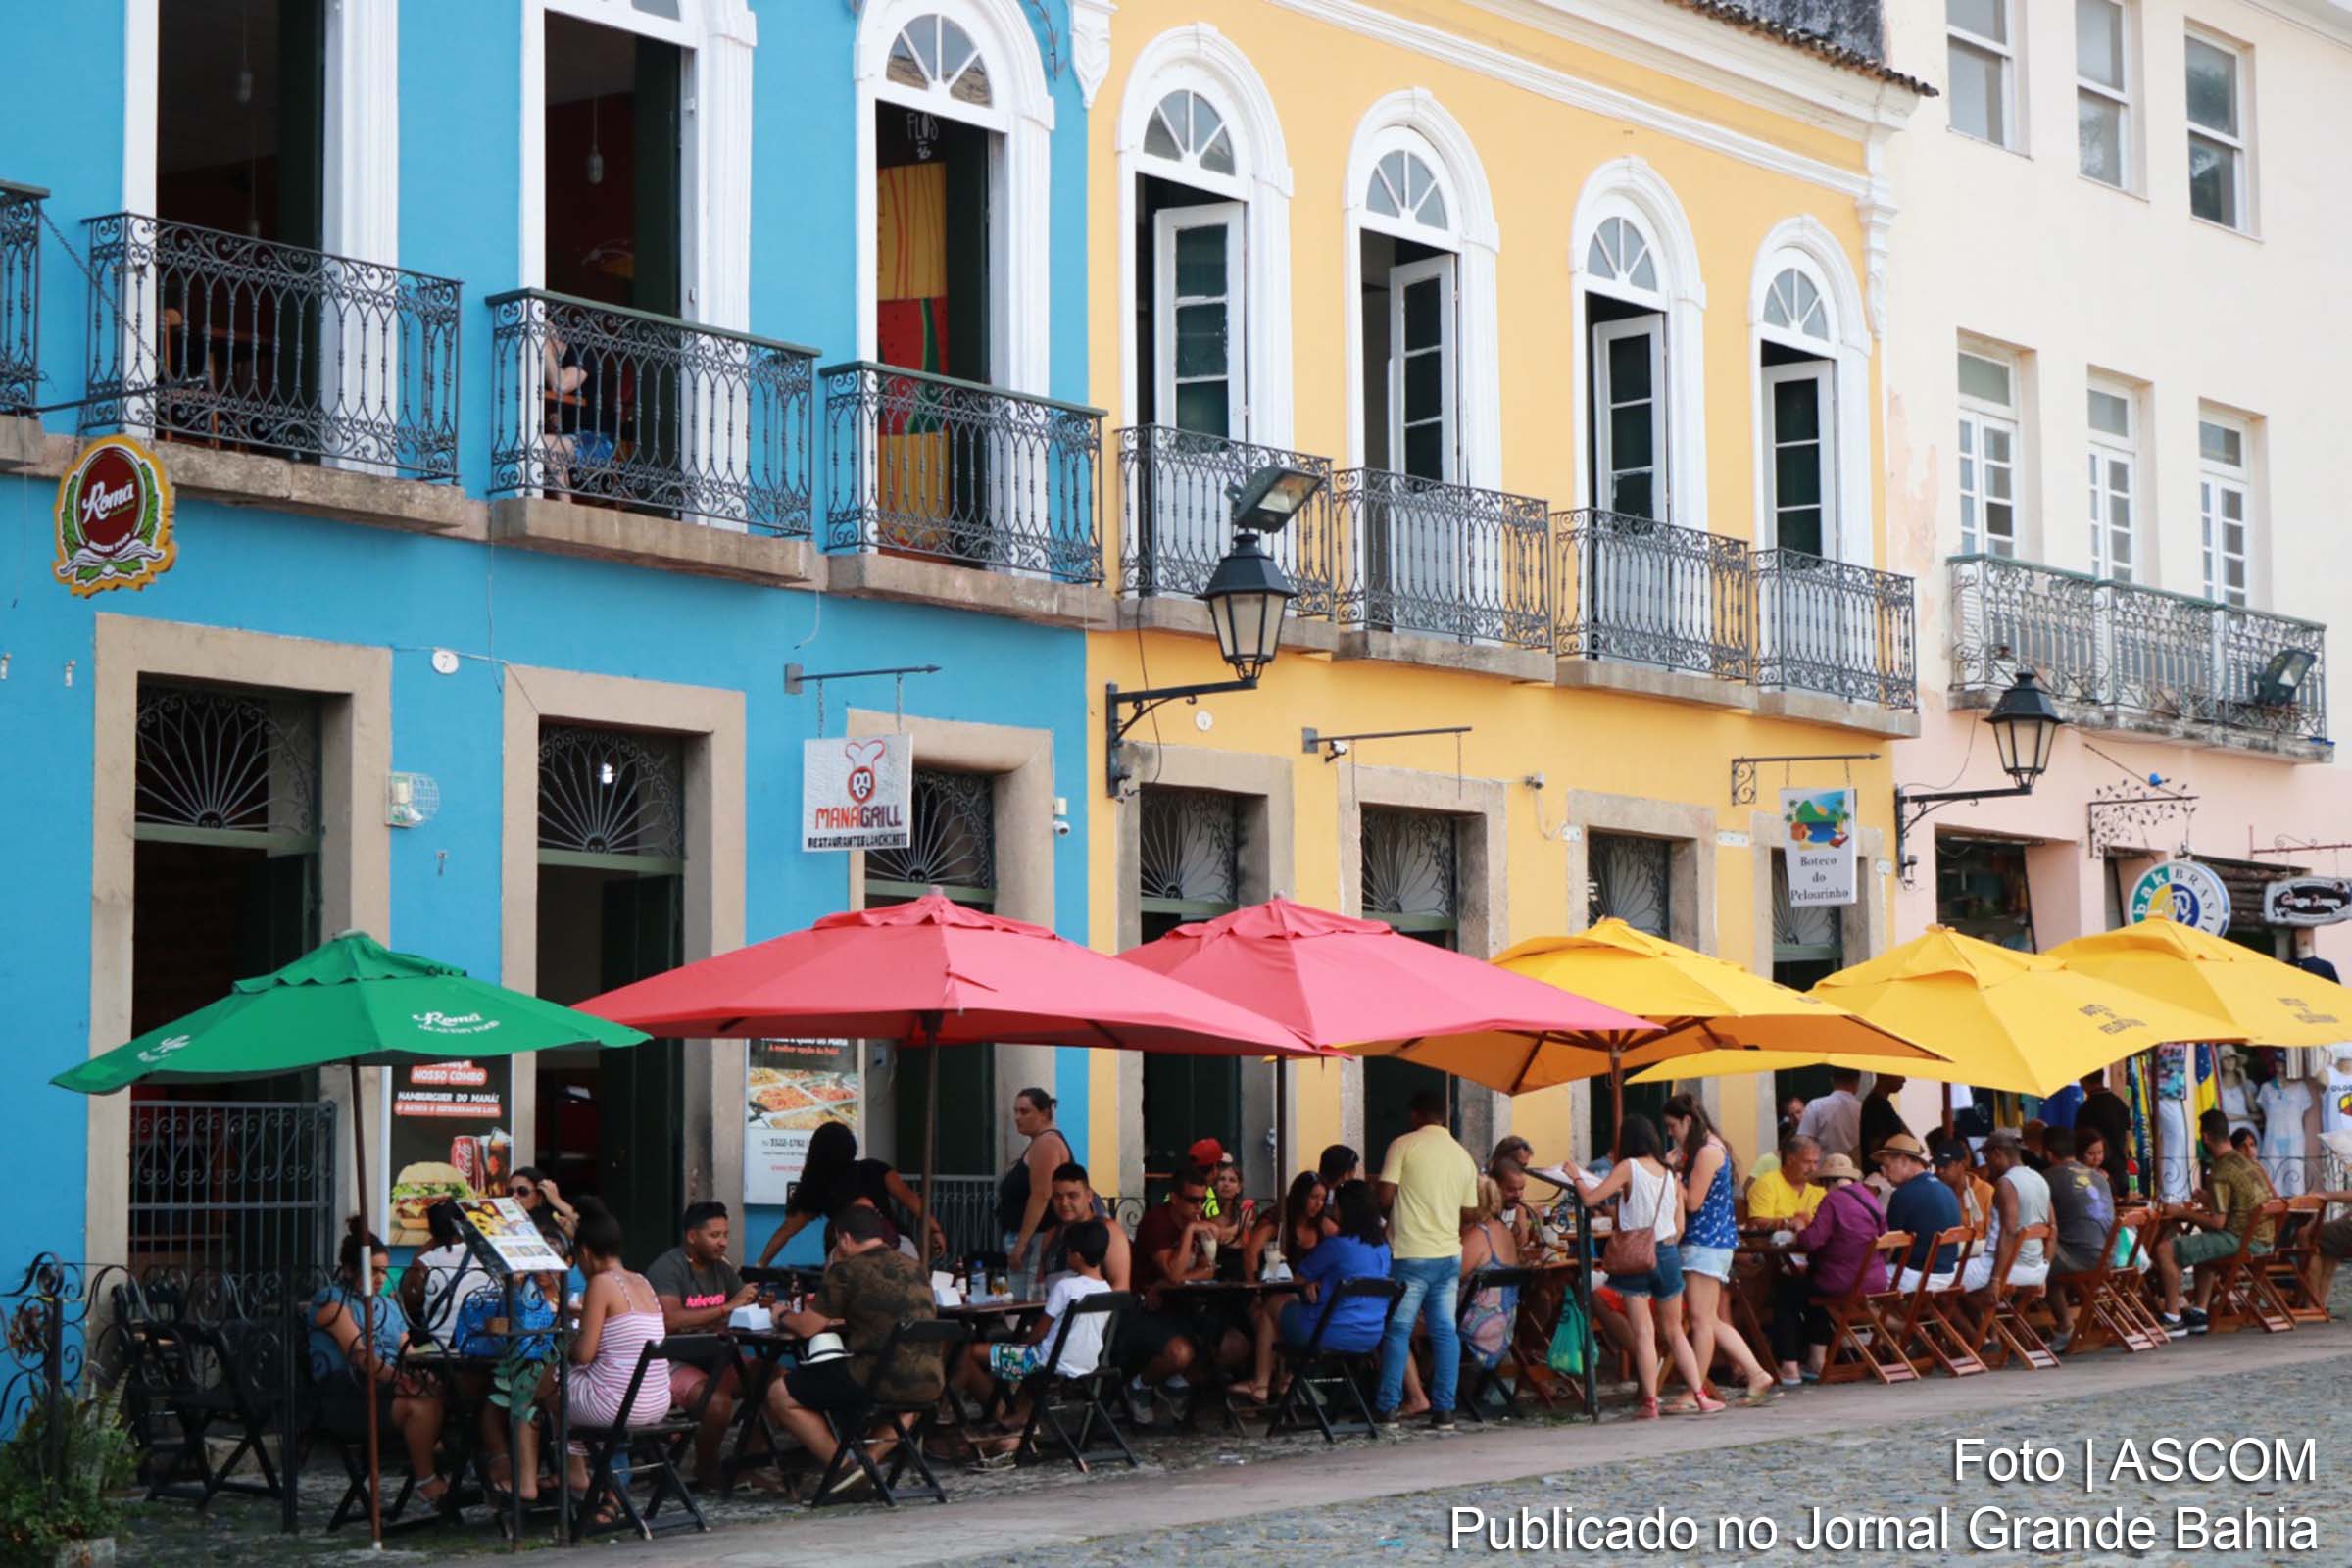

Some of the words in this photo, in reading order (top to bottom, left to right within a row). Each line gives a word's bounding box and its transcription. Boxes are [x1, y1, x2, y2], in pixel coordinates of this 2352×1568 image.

[1801, 856, 1838, 867] Boteco
[1812, 872, 1827, 883] do
[1790, 887, 1849, 901] Pelourinho
[413, 1069, 448, 1082] NOSSO
[450, 1071, 485, 1083] COMBO
[397, 1091, 453, 1102] HAMBURGUER
[455, 1093, 469, 1102] DO
